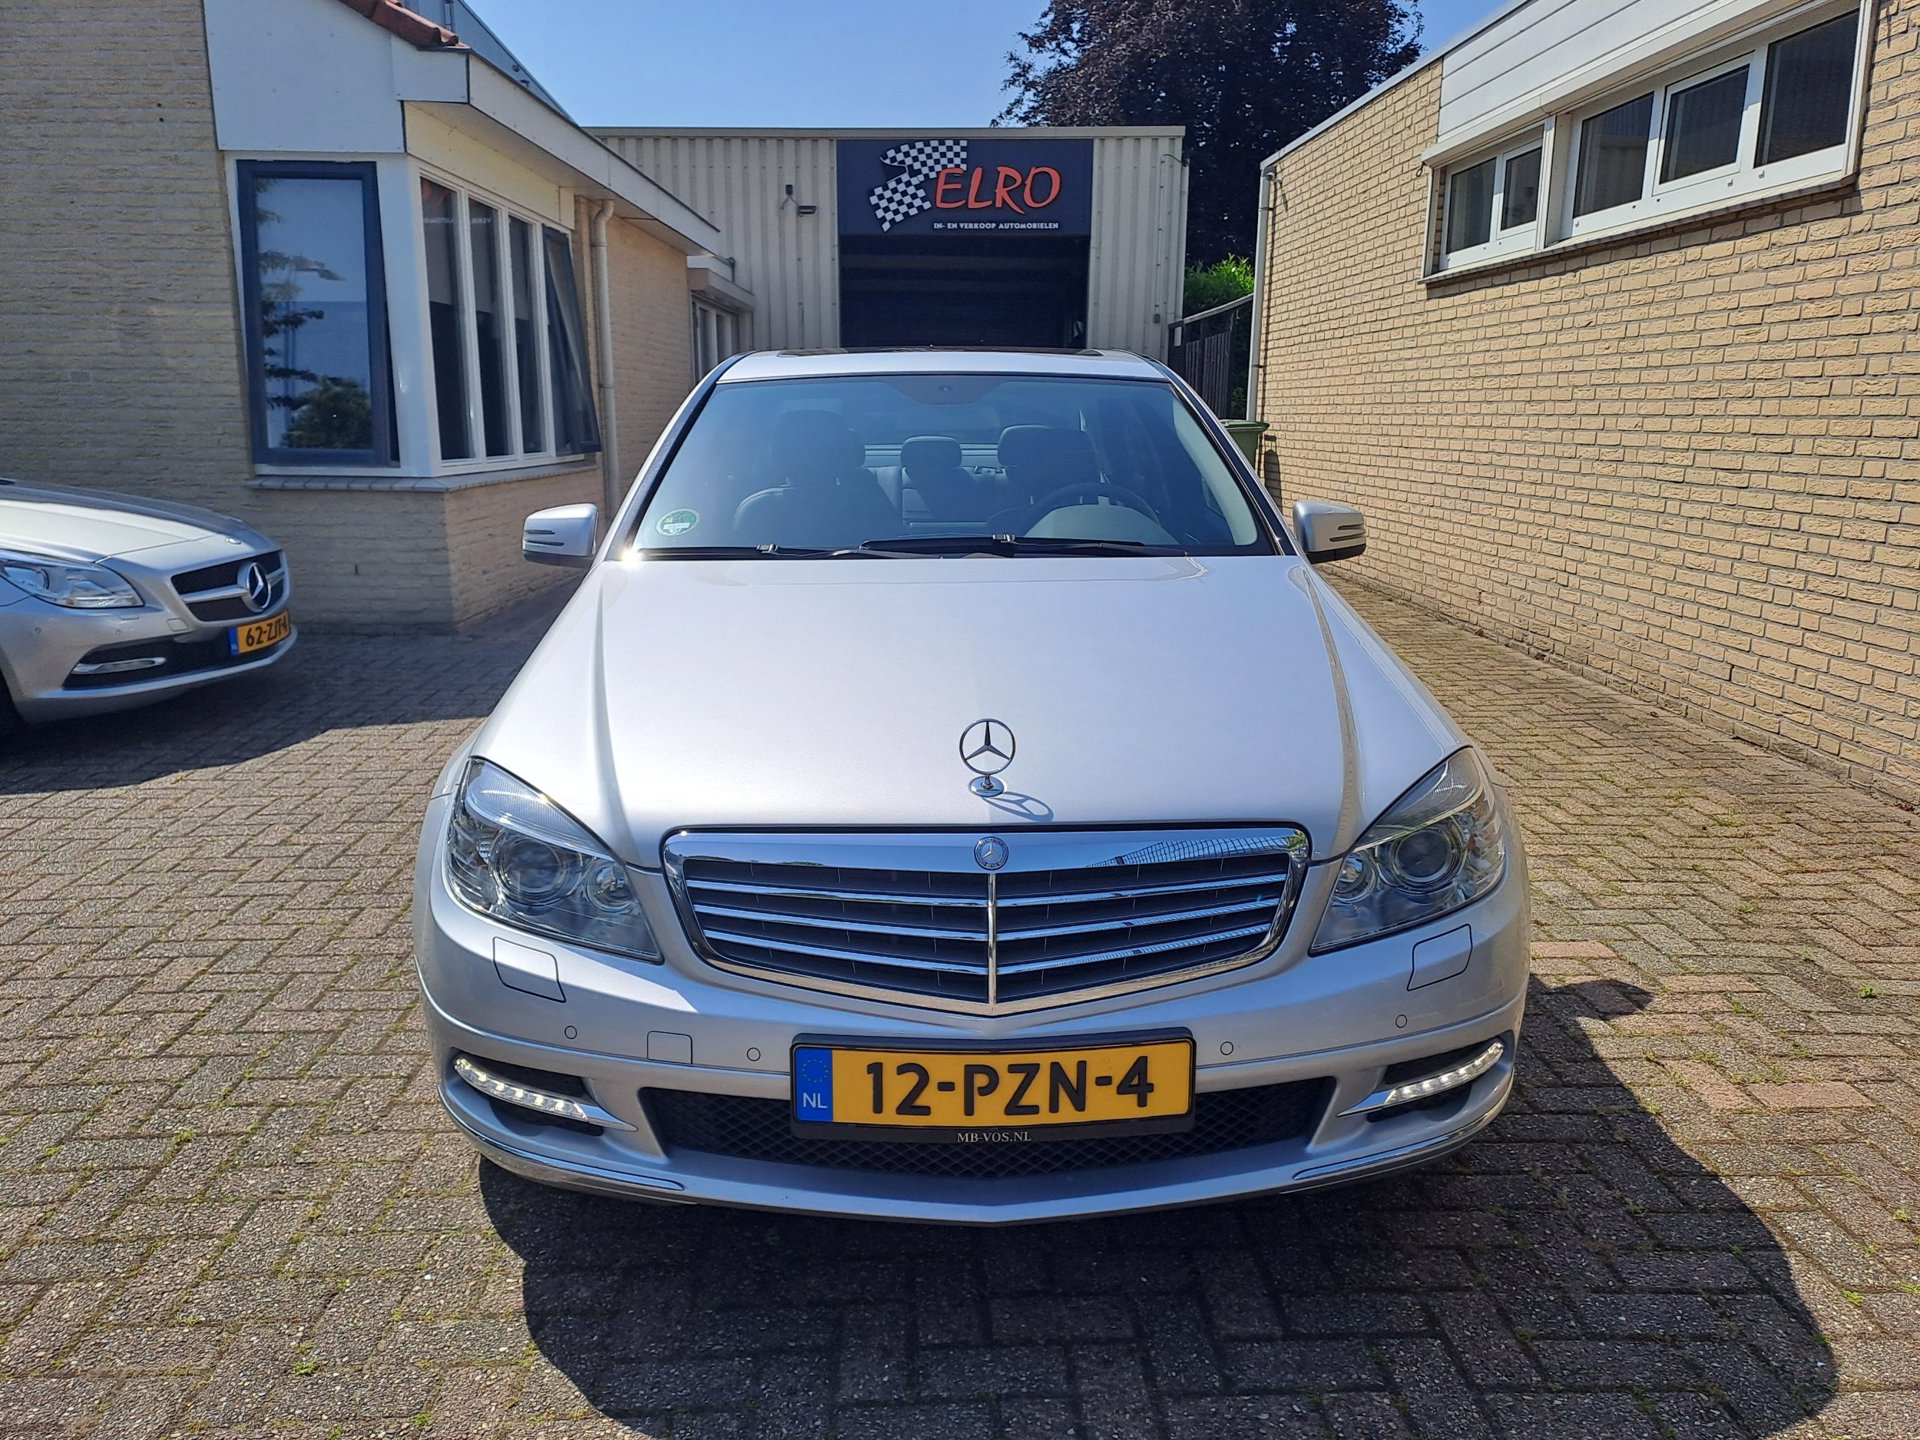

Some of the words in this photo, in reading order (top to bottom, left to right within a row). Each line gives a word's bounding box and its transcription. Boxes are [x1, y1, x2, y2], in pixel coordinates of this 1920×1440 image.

[935, 166, 1062, 214] ELRO
[933, 222, 946, 230] IN-
[947, 222, 958, 230] EN
[959, 222, 997, 230] VERKOOP
[998, 222, 1059, 230] AUTOMOBIELEN
[866, 1055, 1154, 1117] 12-PZN-4
[802, 1092, 828, 1109] NL
[957, 1131, 1032, 1143] MB-VOS.NL
